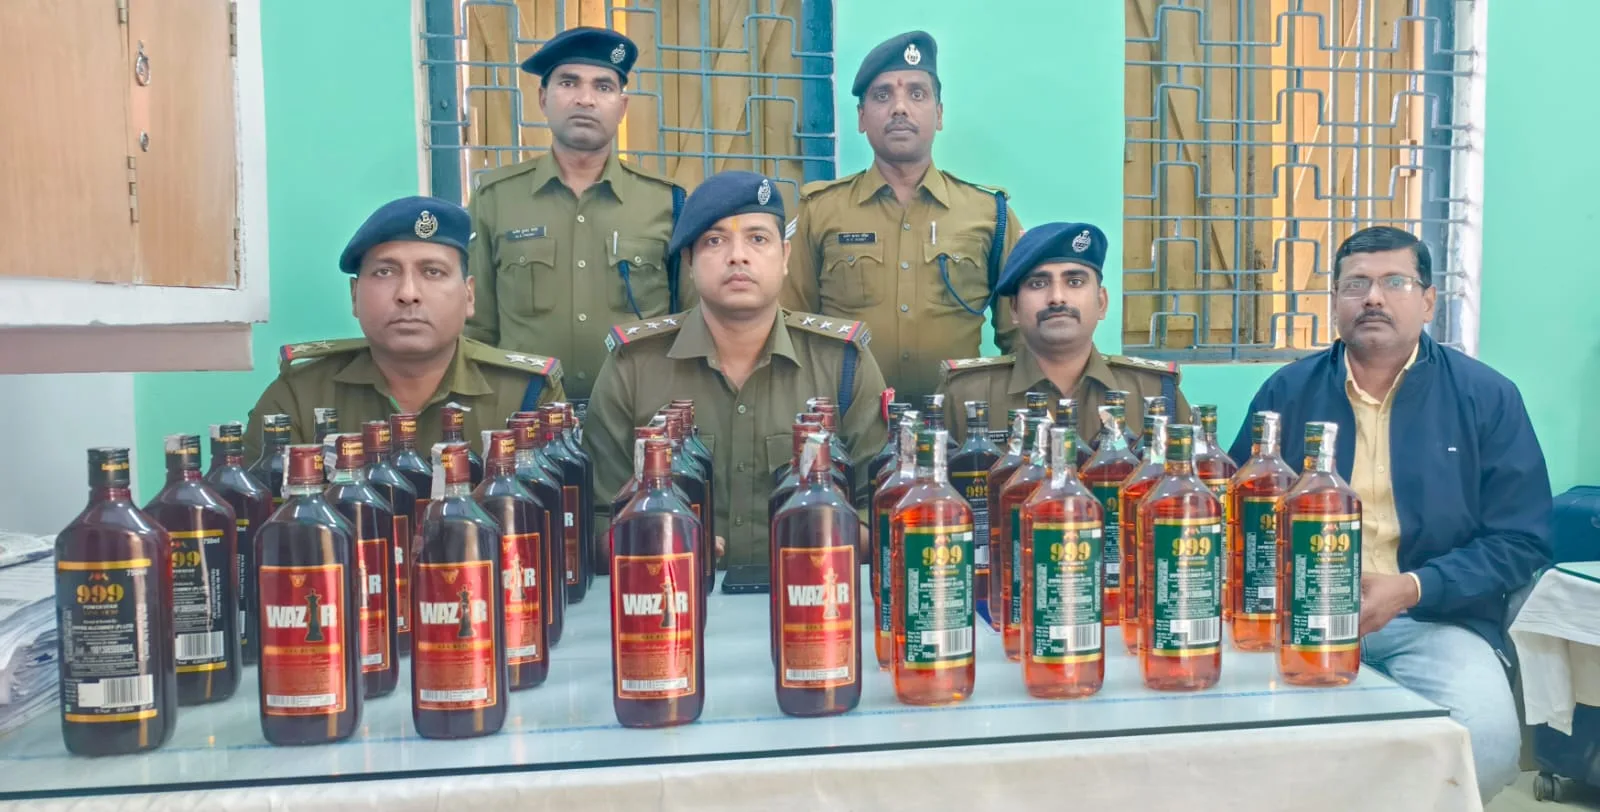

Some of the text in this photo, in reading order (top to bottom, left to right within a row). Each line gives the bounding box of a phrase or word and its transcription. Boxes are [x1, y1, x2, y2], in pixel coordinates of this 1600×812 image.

[1050, 542, 1090, 561] 999
[1172, 537, 1211, 556] 999
[1310, 534, 1350, 552] 999
[922, 545, 962, 566] 999
[76, 584, 124, 604] 999
